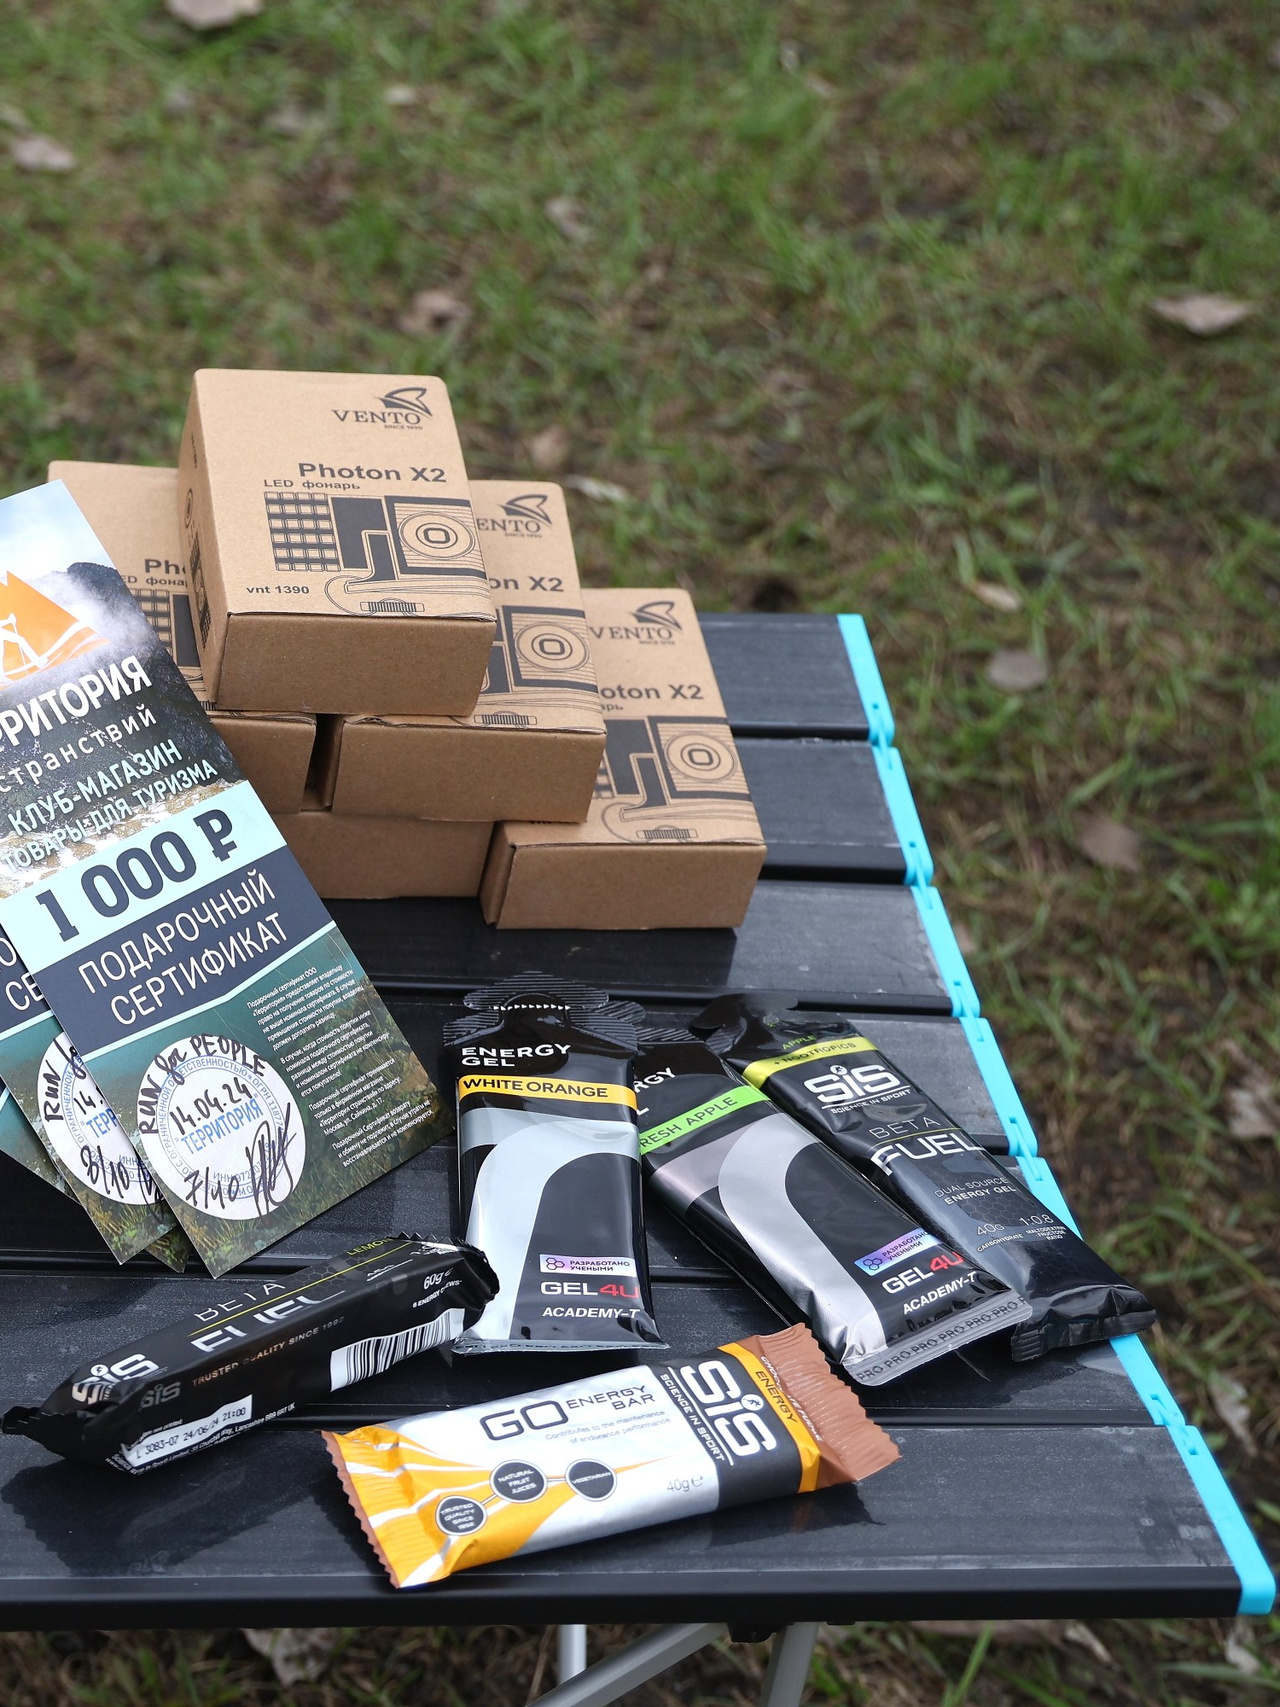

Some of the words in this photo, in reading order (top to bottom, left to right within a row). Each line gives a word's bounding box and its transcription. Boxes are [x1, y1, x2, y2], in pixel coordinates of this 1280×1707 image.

[331, 409, 421, 425] VENTO
[298, 462, 401, 480] Photon
[410, 466, 447, 483] X2
[264, 479, 293, 488] LED
[302, 479, 360, 491] фонарь
[477, 518, 541, 533] ENTO
[246, 586, 271, 594] vnt
[275, 586, 310, 594] 1390
[528, 576, 564, 592] X2
[588, 626, 673, 640] VENTO
[669, 684, 704, 699] X2
[7, 738, 183, 837] КЛУБ-МАГАЗИН
[3, 818, 83, 874] ТОВАРЫ
[92, 800, 133, 834] ДЛЯ
[131, 758, 218, 811] ТУРИЗМА
[36, 888, 79, 941] 1
[81, 831, 197, 918] 000
[77, 869, 277, 994] ПОДАРОЧНЫЙ
[110, 912, 288, 1026] СЕРТИФИКАТ
[461, 1043, 571, 1058] ENERGY
[781, 1034, 818, 1050] APPLE
[461, 1057, 515, 1067] GEL
[783, 1042, 857, 1063] NOOTROPICS
[43, 1059, 64, 1122] RUN
[139, 1074, 162, 1135] RUN
[189, 1032, 267, 1077] PEOPLE
[463, 1078, 523, 1091] WHITE
[526, 1081, 608, 1098] ORANGE
[830, 1100, 866, 1114] SCIENCE
[881, 1089, 912, 1102] SPORT
[181, 1098, 264, 1155] ТЕРРИТОРИЯ
[641, 1123, 684, 1149] RESH
[685, 1096, 738, 1126] APPLE
[869, 1116, 941, 1139] BETA
[870, 1132, 987, 1177] FUEL
[934, 1184, 965, 1198] DUAL
[965, 1177, 1009, 1189] SOURCE
[944, 1188, 991, 1205] ENERGY
[993, 1185, 1017, 1194] GEL
[1019, 1213, 1054, 1227] 1:0.8
[346, 1238, 394, 1256] LEMON
[882, 1231, 931, 1258] РАЗРАБОТАНО
[887, 1241, 923, 1262] УЧЕНЫМИ
[977, 1233, 1024, 1252] CARBOHYDRATE
[423, 1272, 444, 1290] 60g
[881, 1251, 966, 1294] GEL4U
[417, 1289, 440, 1307] ENERGY
[541, 1282, 639, 1298] GEL4U
[903, 1271, 977, 1315] ACADEMY-T
[542, 1307, 640, 1319] ACADEMY-T
[856, 1365, 883, 1381] PRO
[883, 1351, 910, 1369] PRO
[911, 1338, 938, 1355] PRO
[938, 1325, 965, 1342] PRO
[964, 1313, 992, 1330] PRO
[992, 1301, 1019, 1318] PRO
[191, 1361, 239, 1387] TRUSTED
[288, 1327, 319, 1346] SINCE
[613, 1393, 656, 1410] BAR
[755, 1370, 798, 1423] ENERGY
[479, 1400, 569, 1441] GO
[565, 1385, 646, 1409] ENERGY
[660, 1374, 694, 1415] SCIENCE
[689, 1415, 701, 1426] IN
[697, 1427, 725, 1461] SPORT
[183, 1417, 219, 1441] 24/06/24
[222, 1407, 246, 1422] 21:00
[545, 1425, 591, 1441] Contributes
[601, 1420, 615, 1429] the
[616, 1410, 666, 1425] maintenance
[580, 1430, 621, 1442] endurance
[622, 1417, 671, 1435] performance
[498, 1468, 534, 1482] NATURAL
[508, 1476, 530, 1487] FRUIT
[571, 1471, 612, 1485] VEGETARIAN
[511, 1482, 537, 1494] JUICES
[667, 1478, 690, 1493] 40g
[440, 1503, 474, 1515] TRUSTED
[444, 1508, 476, 1521] QUALITY
[451, 1515, 475, 1525] SINCE
